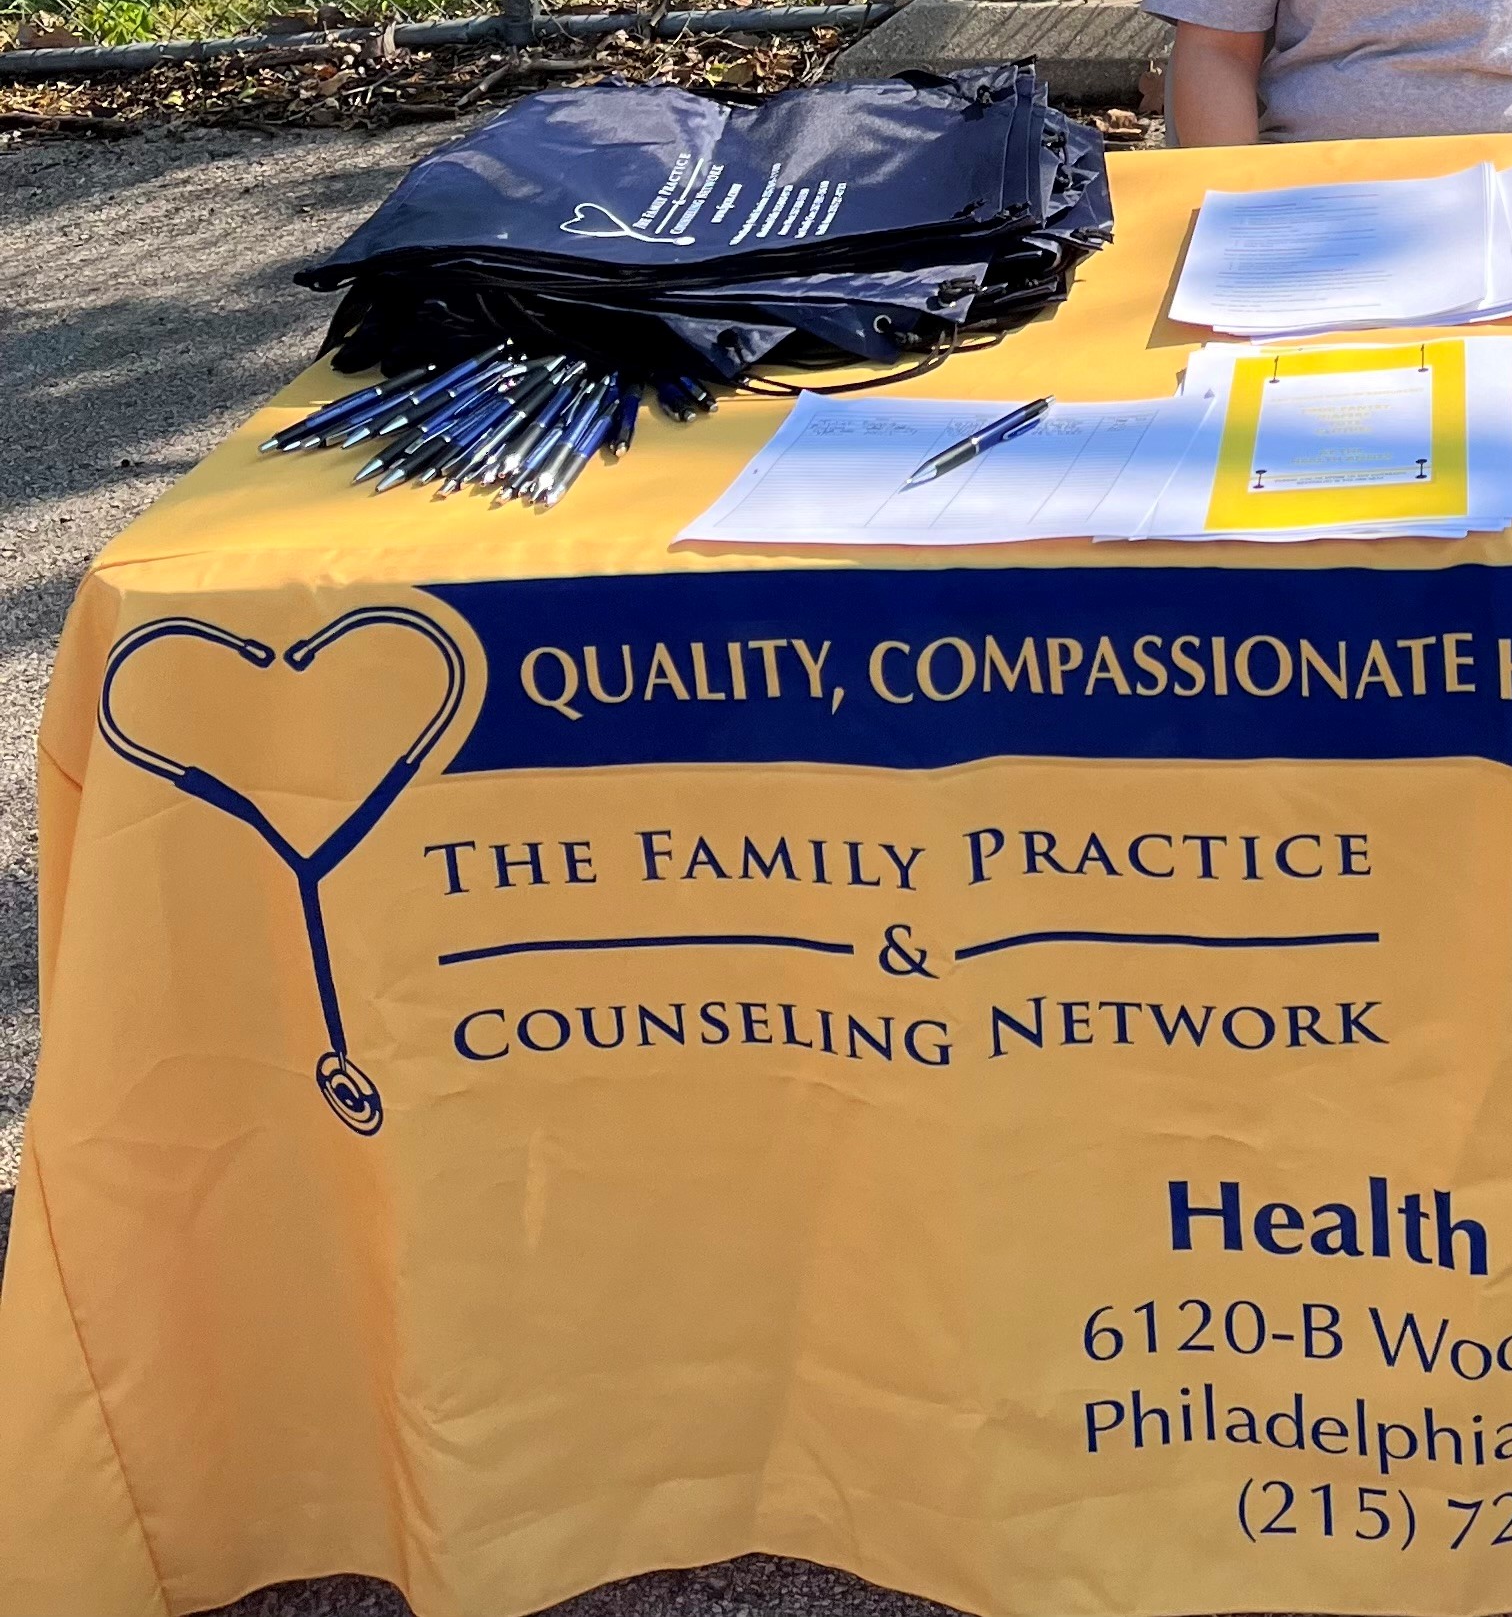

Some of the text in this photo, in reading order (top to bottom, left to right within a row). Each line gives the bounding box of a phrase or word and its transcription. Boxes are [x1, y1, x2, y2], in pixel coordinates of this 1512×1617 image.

[520, 638, 844, 720] QUALITY,
[868, 632, 1476, 704] COMPASSIONATE
[423, 827, 1372, 896] THE FAMILY PRACTICE
[878, 923, 939, 980] &
[453, 996, 1390, 1066] COUNSELING NETWORK
[1167, 1175, 1489, 1276] Health
[1083, 1299, 1343, 1361] 6120-B
[1238, 1478, 1417, 1551] (215)
